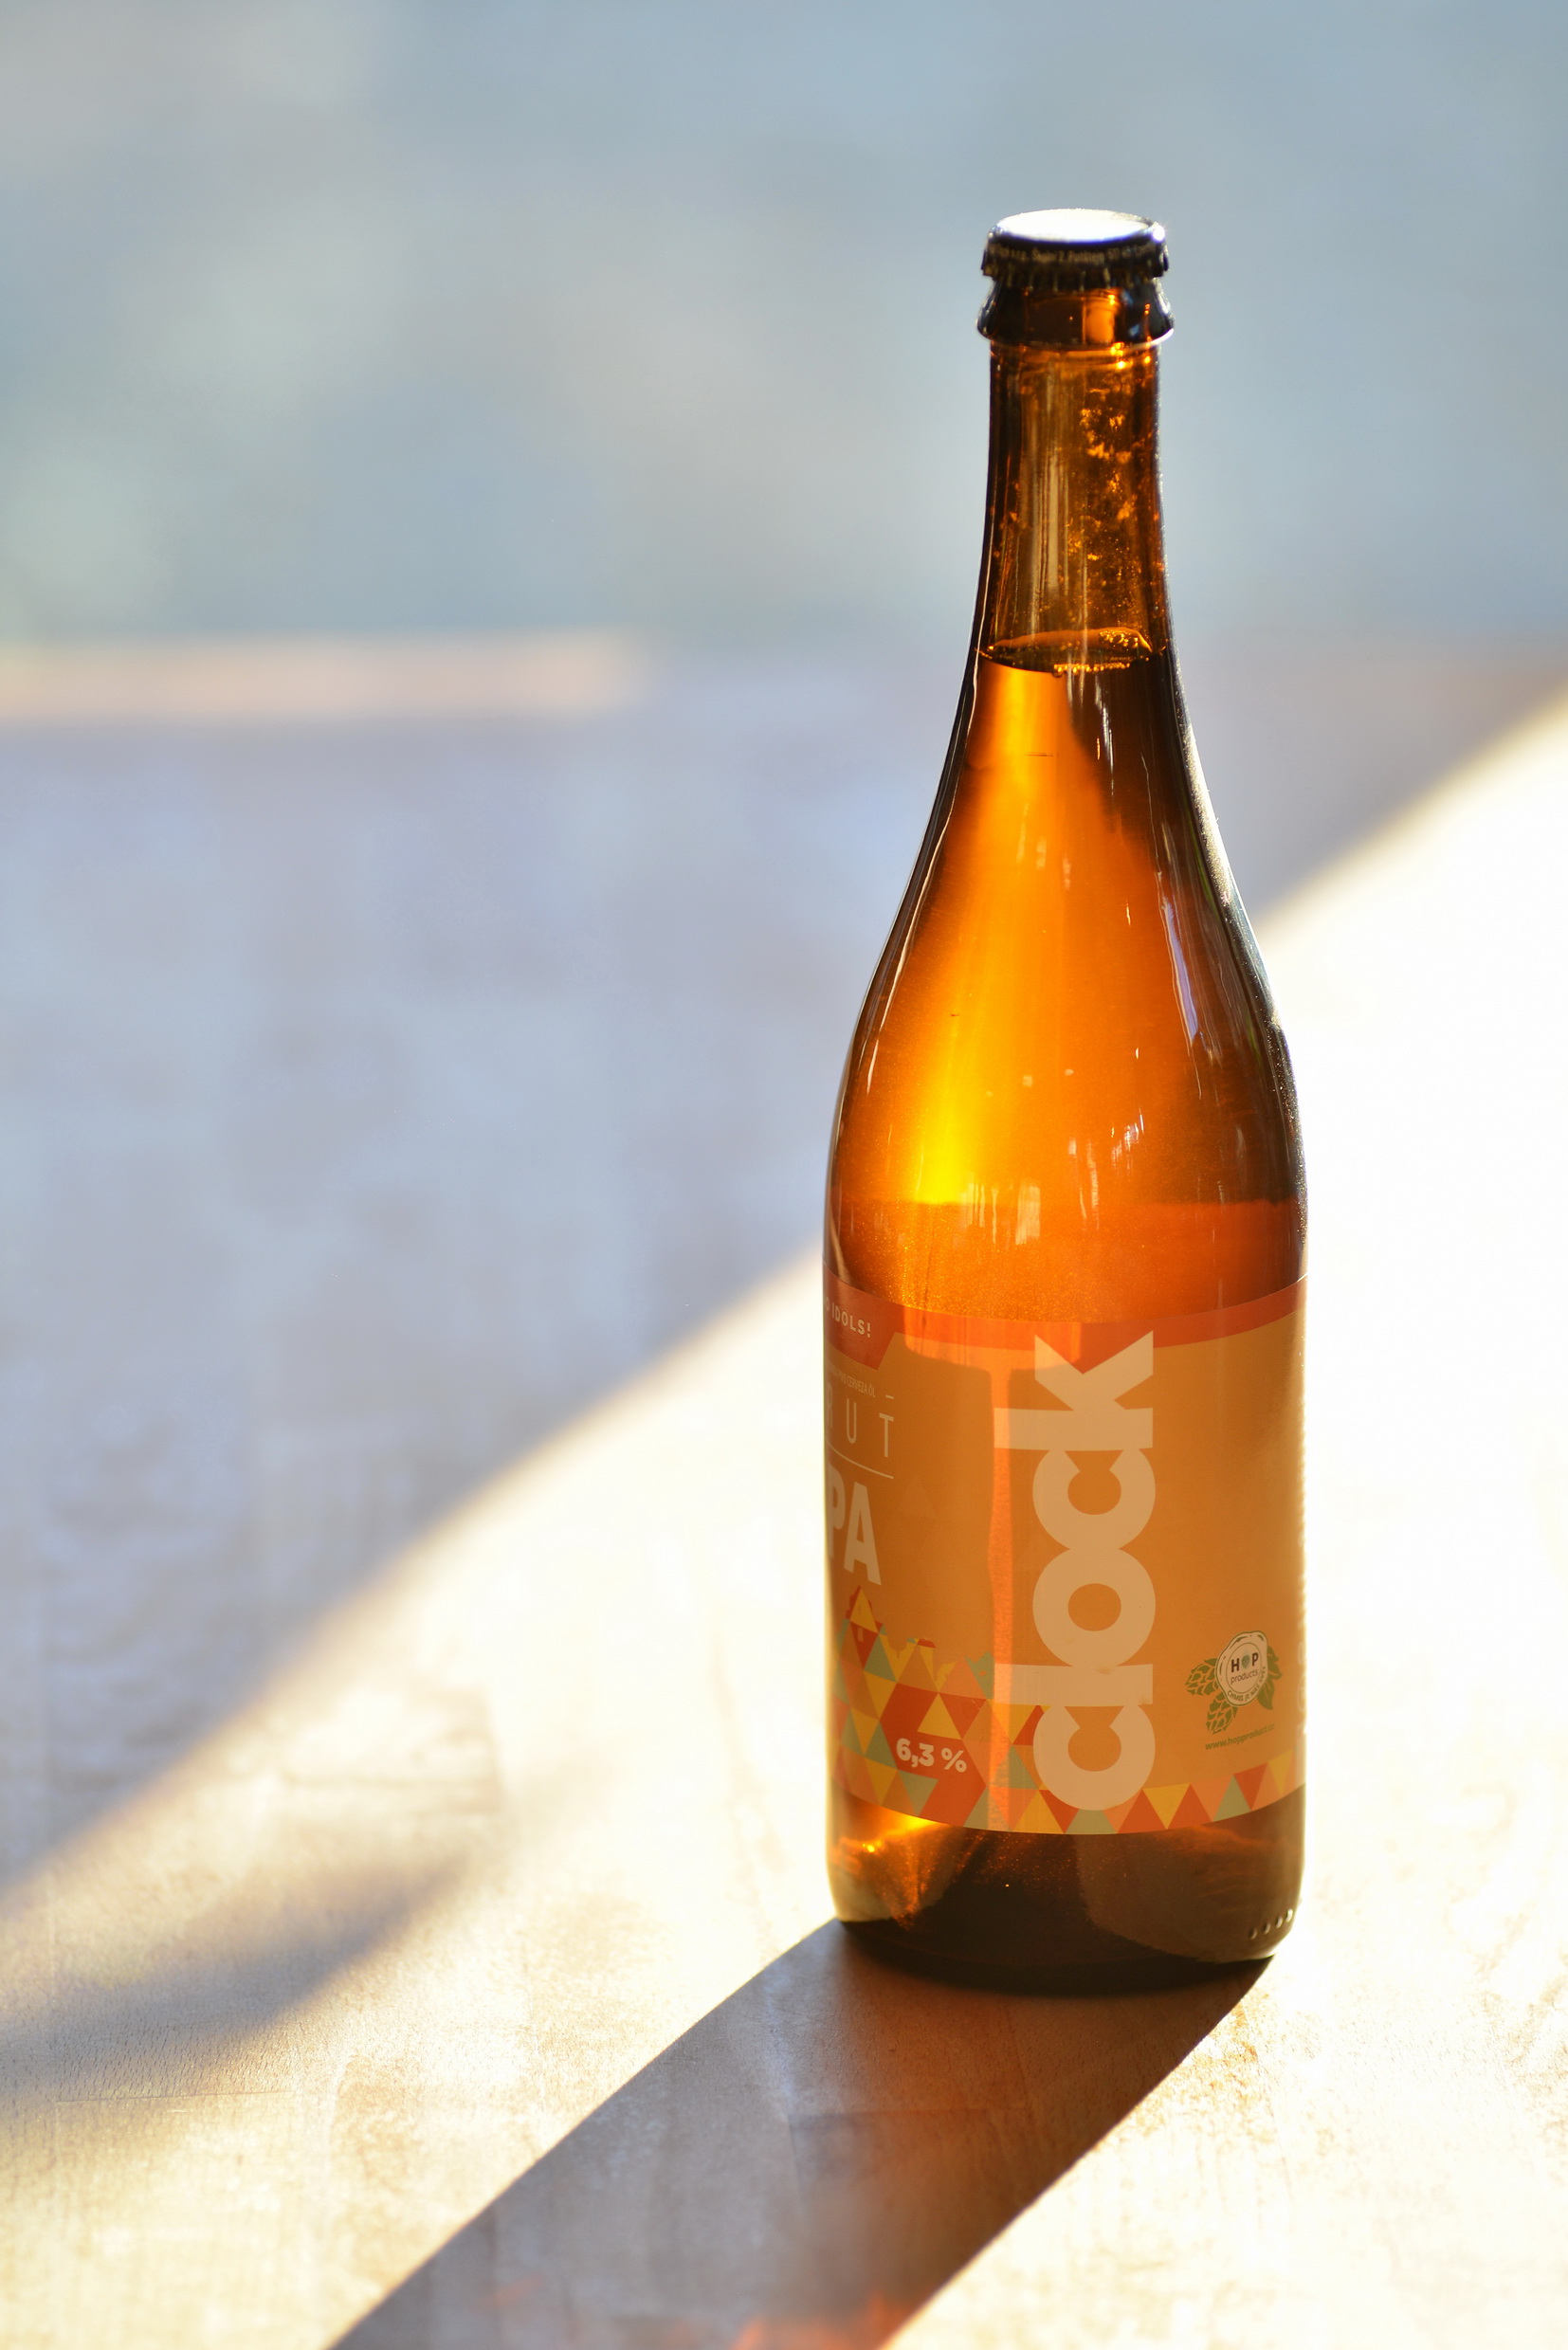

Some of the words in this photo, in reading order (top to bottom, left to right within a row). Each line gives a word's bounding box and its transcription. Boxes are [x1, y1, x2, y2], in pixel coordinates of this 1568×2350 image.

[831, 1302, 871, 1338] IDOLS!
[825, 1460, 883, 1586] PA
[994, 1330, 1157, 1811] clock
[1231, 1669, 1259, 1685] products
[896, 1738, 935, 1768] 6,3
[940, 1747, 967, 1773] %
